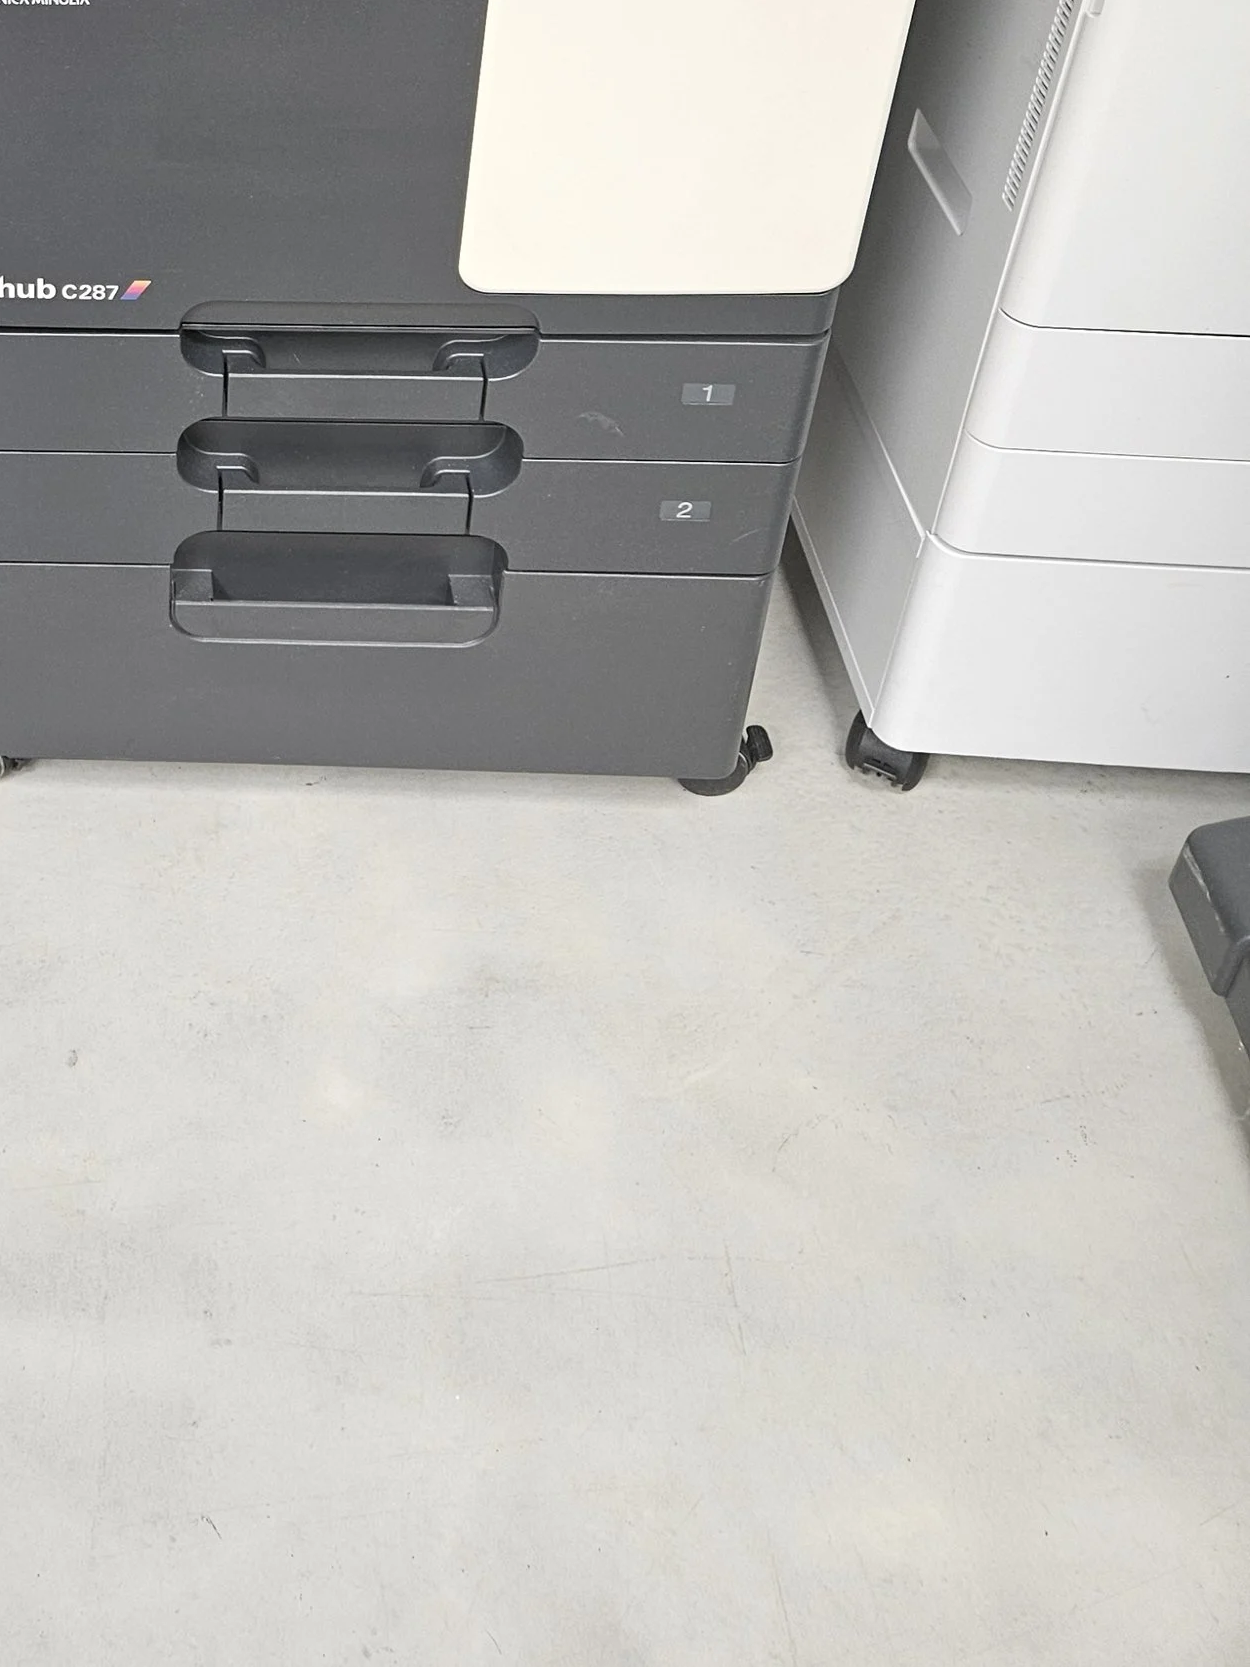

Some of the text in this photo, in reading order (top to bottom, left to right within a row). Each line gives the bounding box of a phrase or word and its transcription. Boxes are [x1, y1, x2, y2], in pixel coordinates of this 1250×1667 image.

[61, 284, 119, 300] C287
[702, 385, 713, 402] 1
[676, 502, 693, 518] 2
